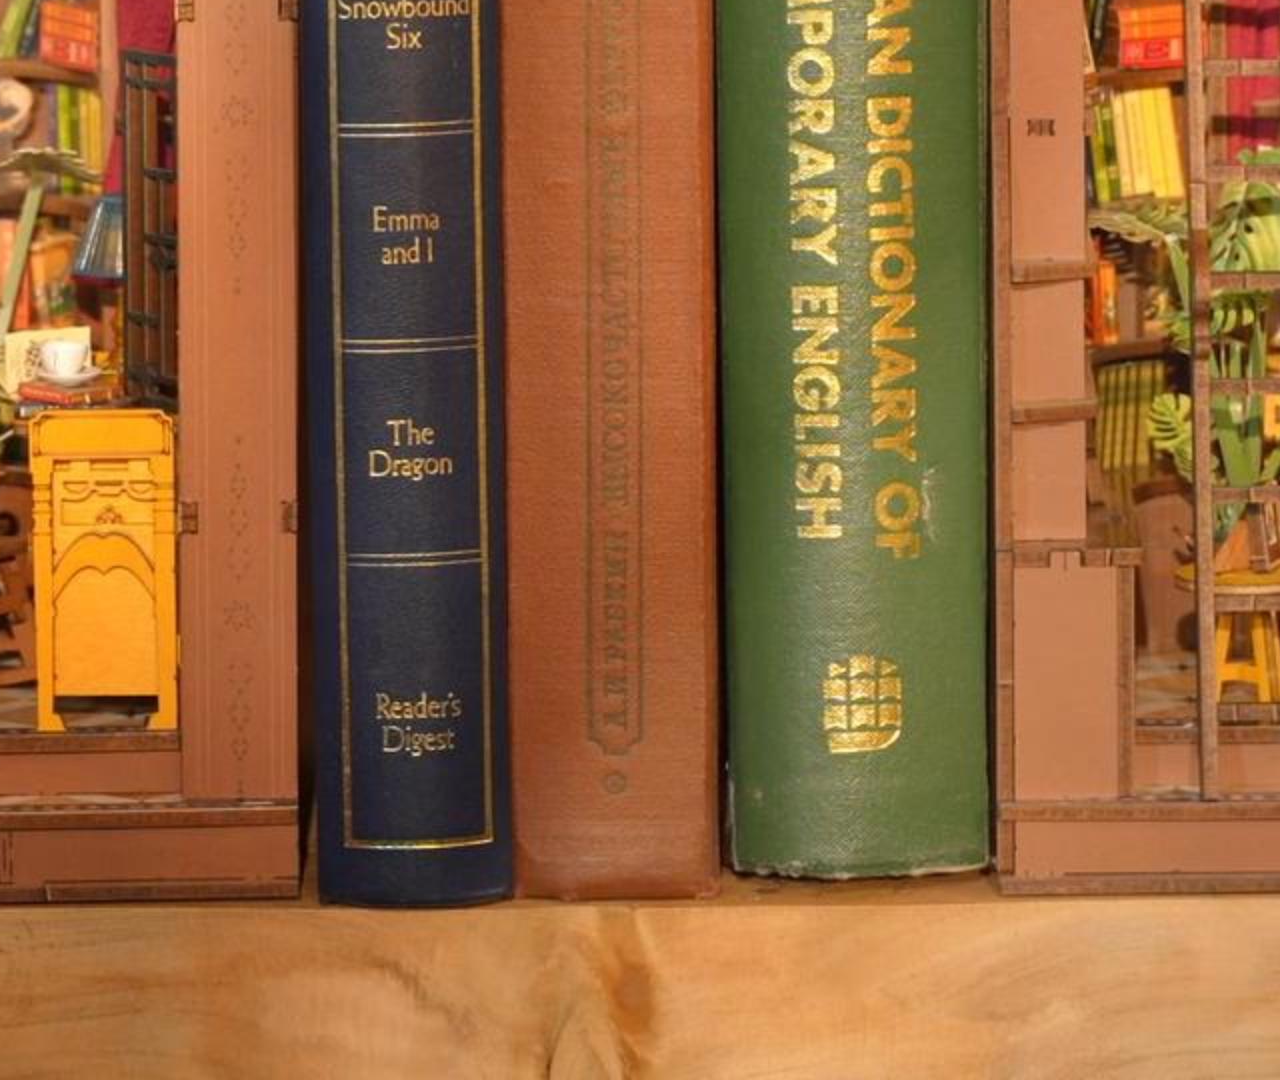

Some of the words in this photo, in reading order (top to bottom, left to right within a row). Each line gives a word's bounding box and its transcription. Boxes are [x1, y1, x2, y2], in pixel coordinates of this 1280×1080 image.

[386, 23, 422, 50] Six
[373, 205, 440, 233] Emma
[382, 237, 420, 265] and
[864, 95, 916, 463] DICTIONARY
[790, 285, 844, 540] ENGLISH
[386, 419, 435, 447] The
[368, 450, 453, 482] Dragon
[873, 481, 921, 560] OF
[375, 691, 463, 720] Reader's
[381, 725, 456, 758] Digest
